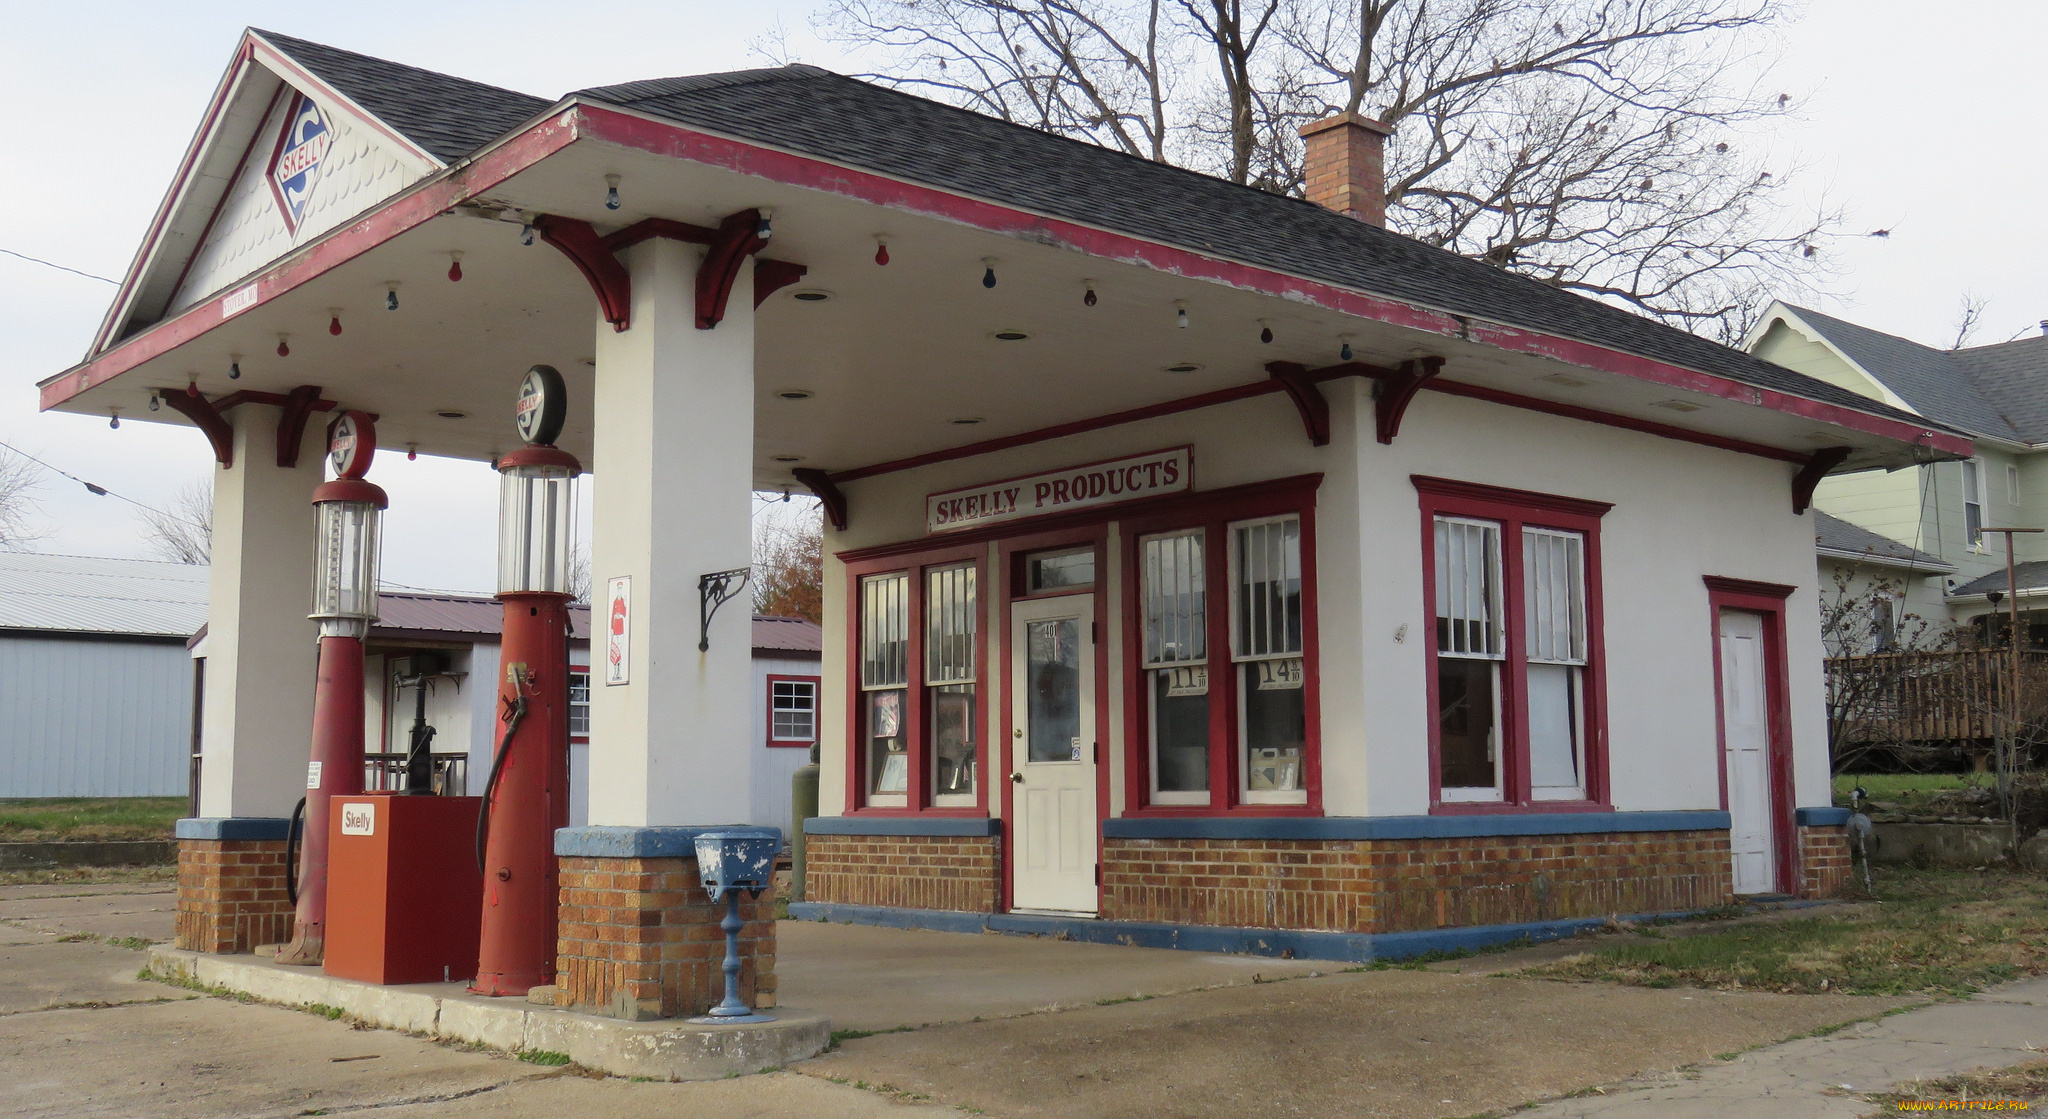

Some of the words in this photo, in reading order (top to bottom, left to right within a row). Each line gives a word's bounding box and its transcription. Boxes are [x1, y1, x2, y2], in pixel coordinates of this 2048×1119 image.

[282, 132, 326, 180] SKELLY
[936, 487, 1021, 525] SKELLY
[1034, 458, 1179, 508] PRODUCTS
[345, 811, 371, 832] Skelly
